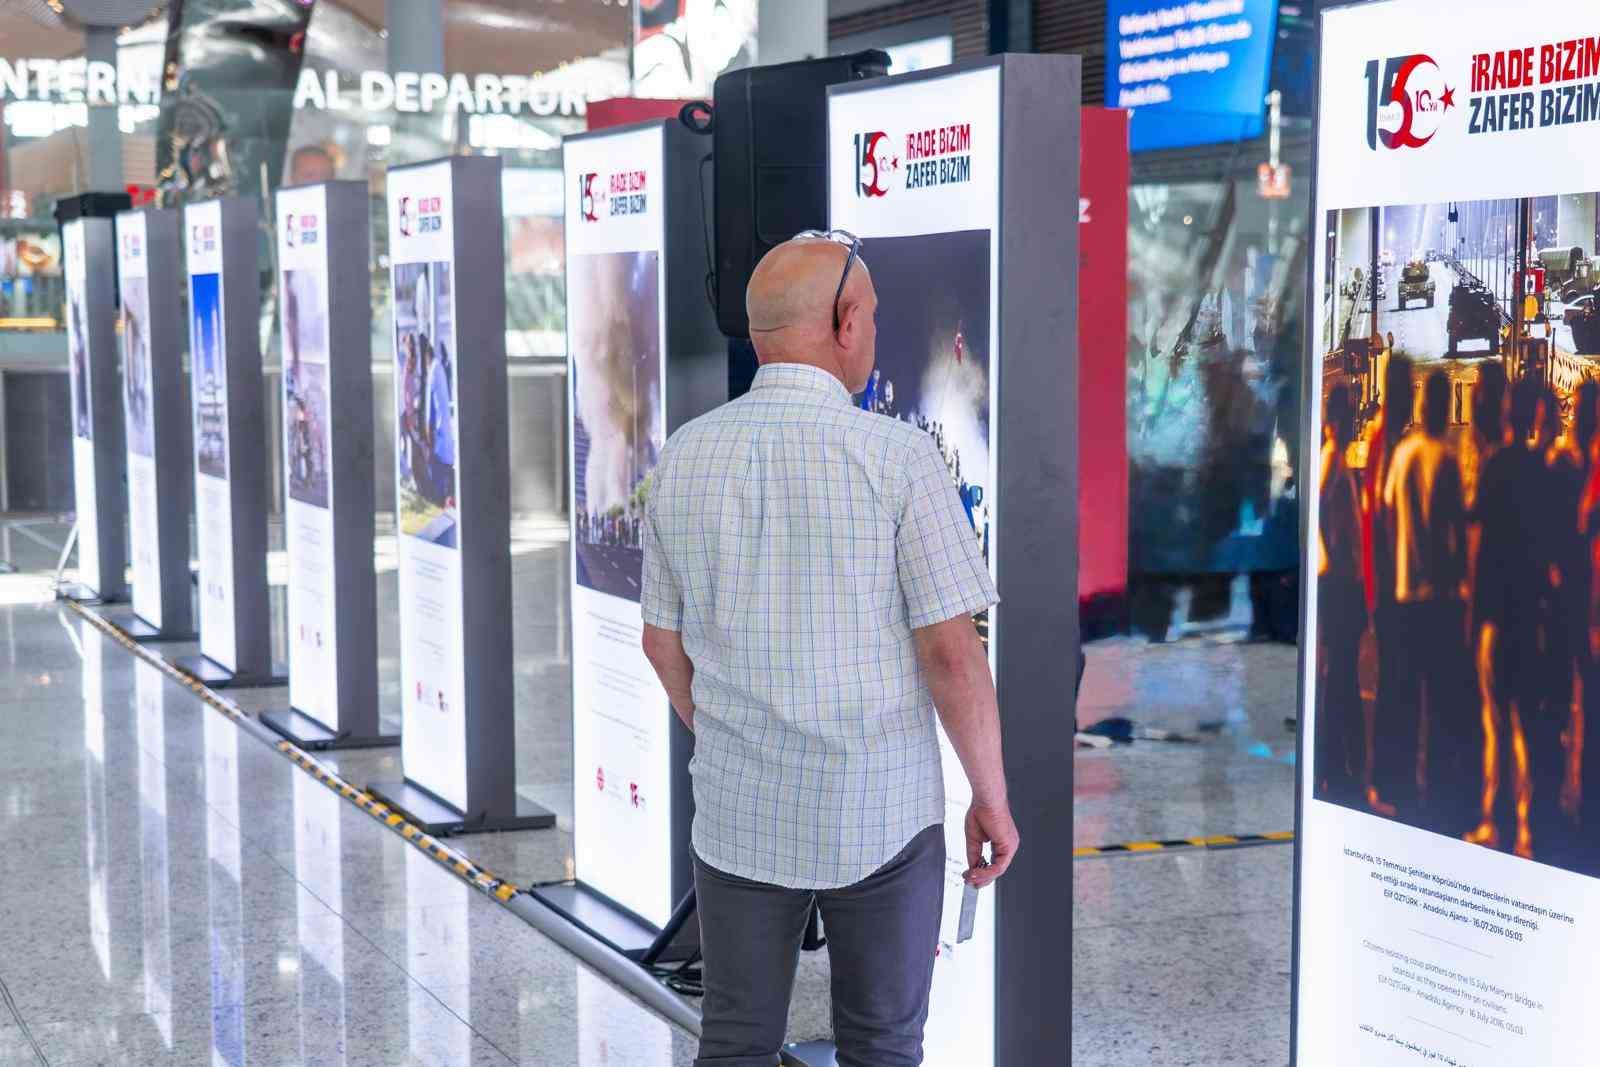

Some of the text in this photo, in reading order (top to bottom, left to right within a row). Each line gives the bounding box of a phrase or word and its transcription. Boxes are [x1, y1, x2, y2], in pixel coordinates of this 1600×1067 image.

[1471, 35, 1600, 92] İRADE BİZİM
[1468, 81, 1600, 134] ZAFER BİZİM
[905, 123, 971, 160] İRADE BİZİM
[905, 160, 937, 189] ZAFER
[940, 155, 971, 185] BİZİM
